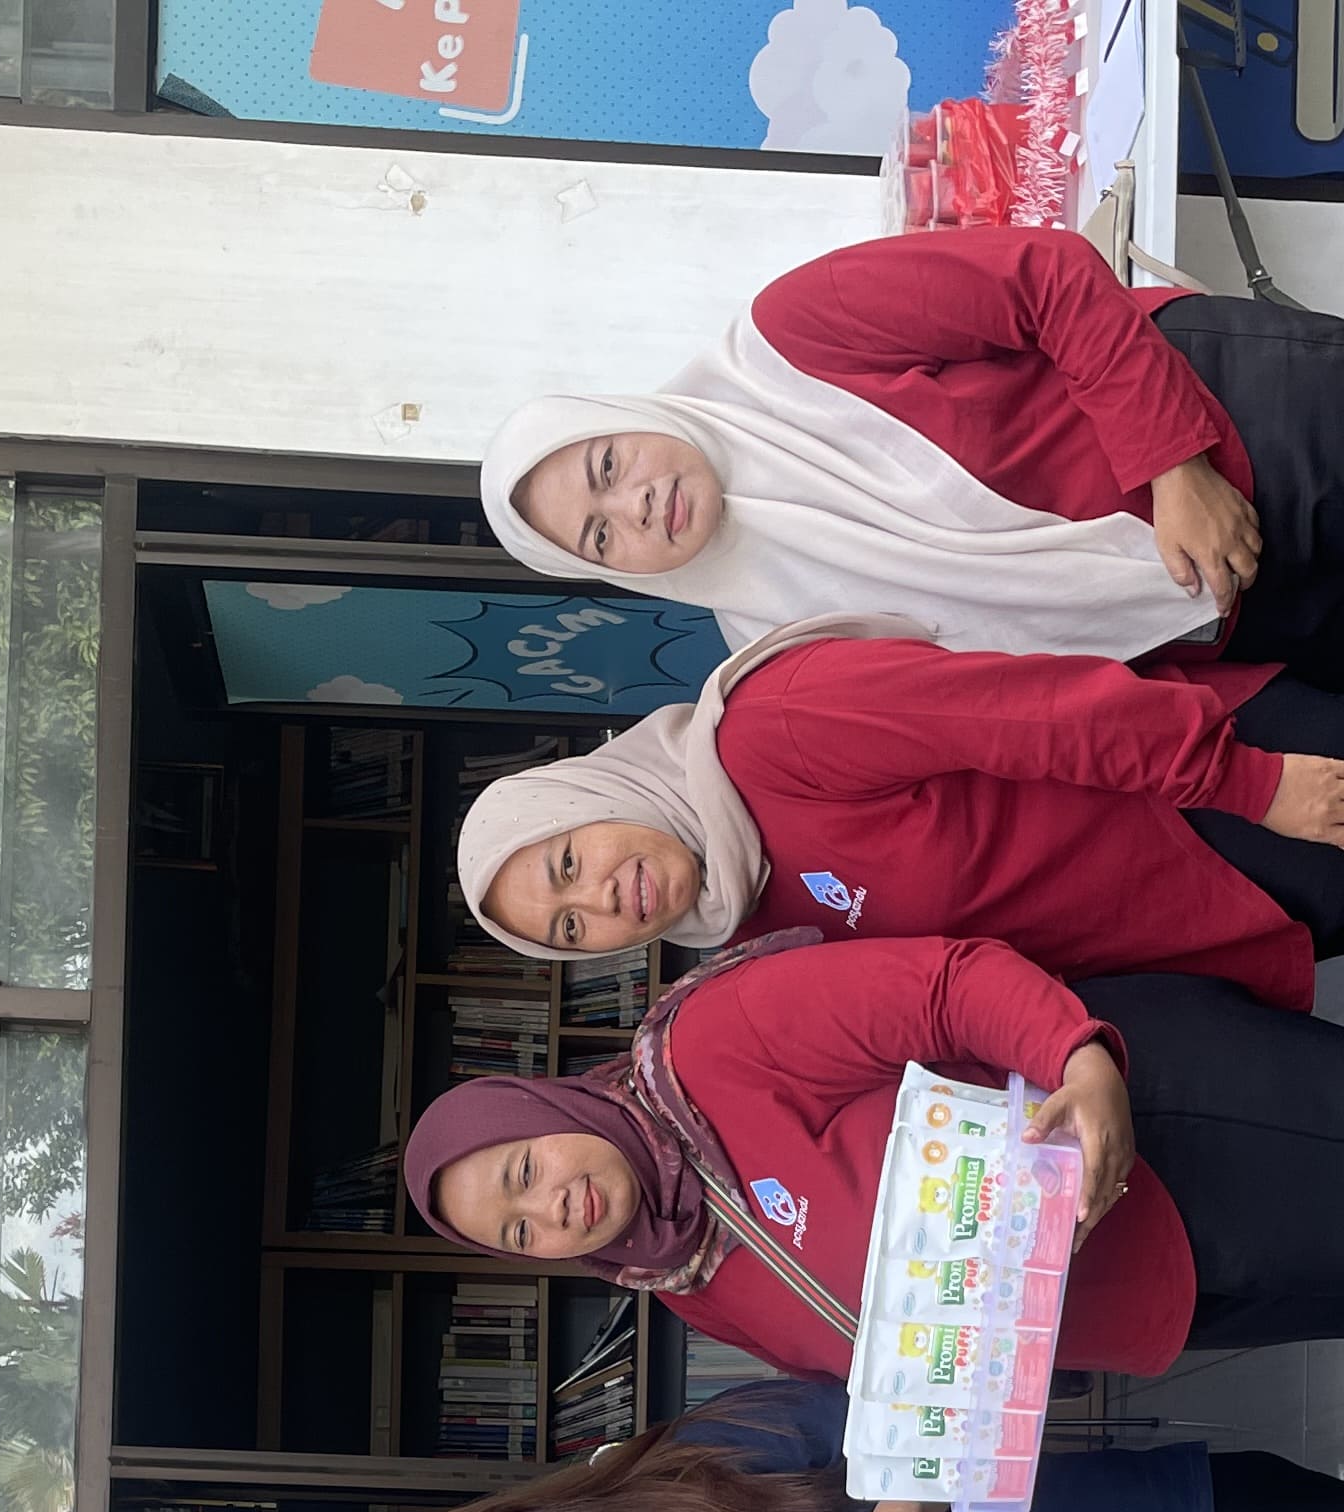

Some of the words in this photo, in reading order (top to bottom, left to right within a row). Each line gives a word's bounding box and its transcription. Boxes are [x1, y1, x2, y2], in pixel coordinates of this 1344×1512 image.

[846, 886, 867, 930] posyandu
[792, 1196, 809, 1250] posyandu
[955, 1161, 980, 1237] Promina
[932, 1328, 956, 1381] Promi
